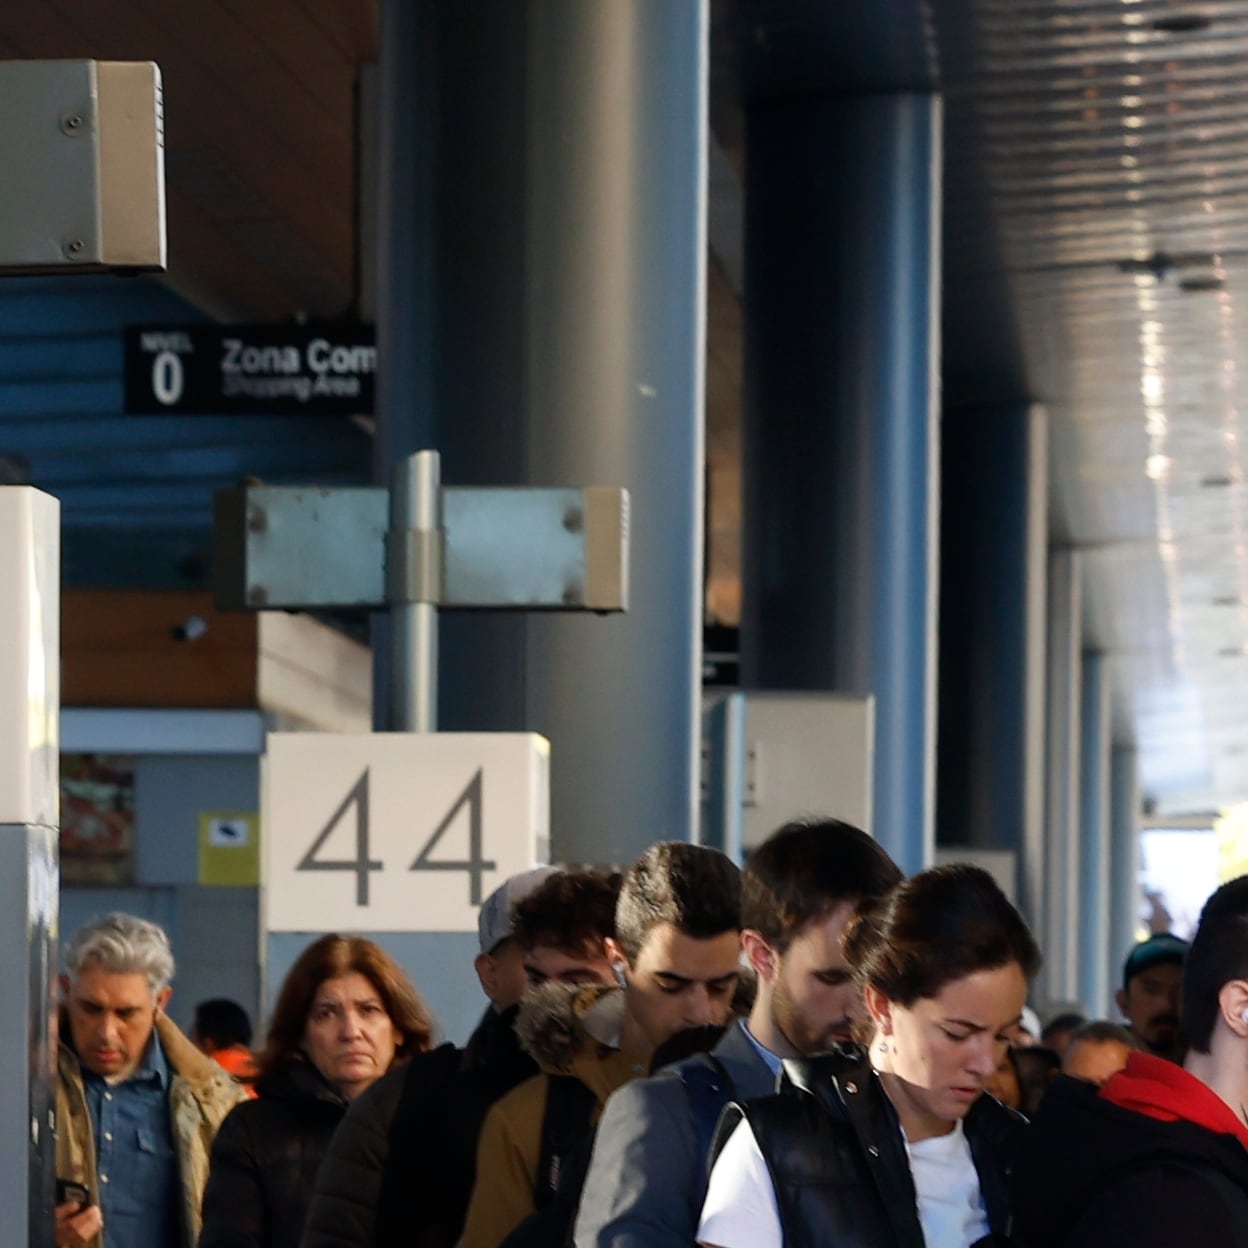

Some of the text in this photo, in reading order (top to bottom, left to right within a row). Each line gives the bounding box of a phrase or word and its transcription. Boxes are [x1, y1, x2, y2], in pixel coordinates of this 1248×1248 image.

[152, 352, 184, 405] 0
[221, 338, 299, 373] Zona
[296, 765, 496, 906] 44
